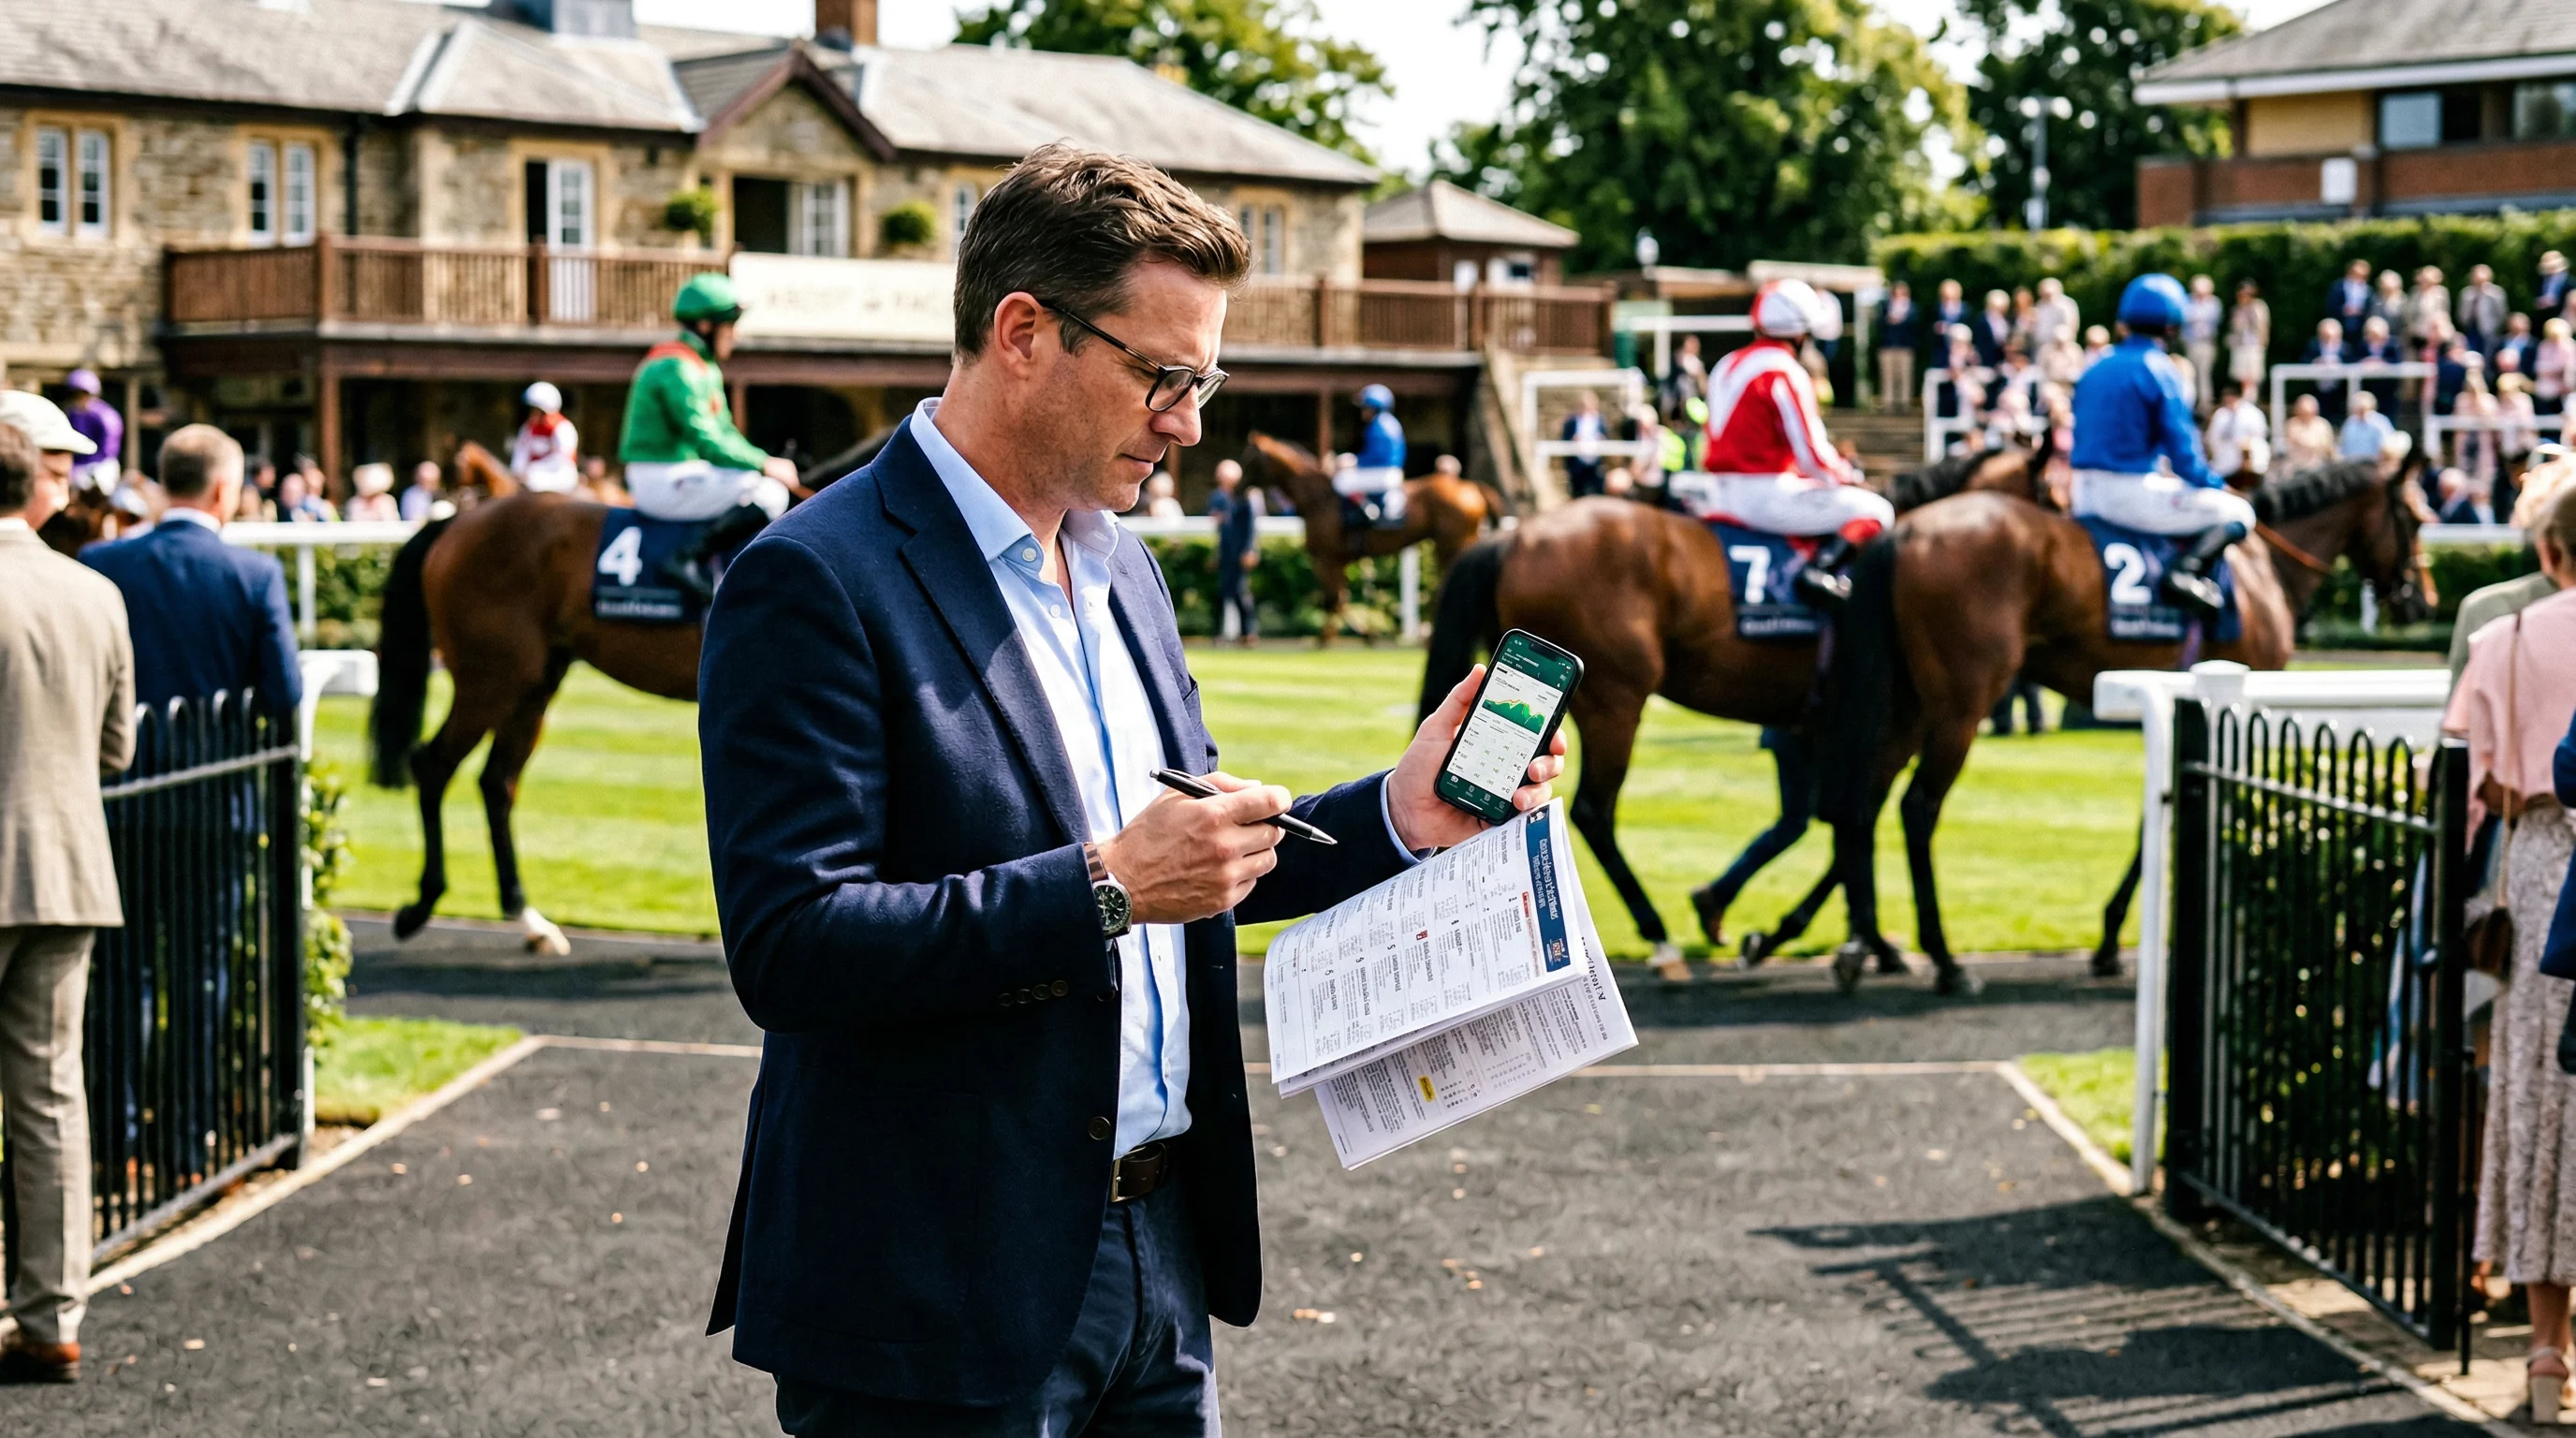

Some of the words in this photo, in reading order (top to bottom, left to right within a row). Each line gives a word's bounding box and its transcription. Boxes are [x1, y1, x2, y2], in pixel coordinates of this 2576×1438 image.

[597, 526, 642, 586] 4
[1728, 545, 1771, 604] 7
[2103, 542, 2151, 605] 2
